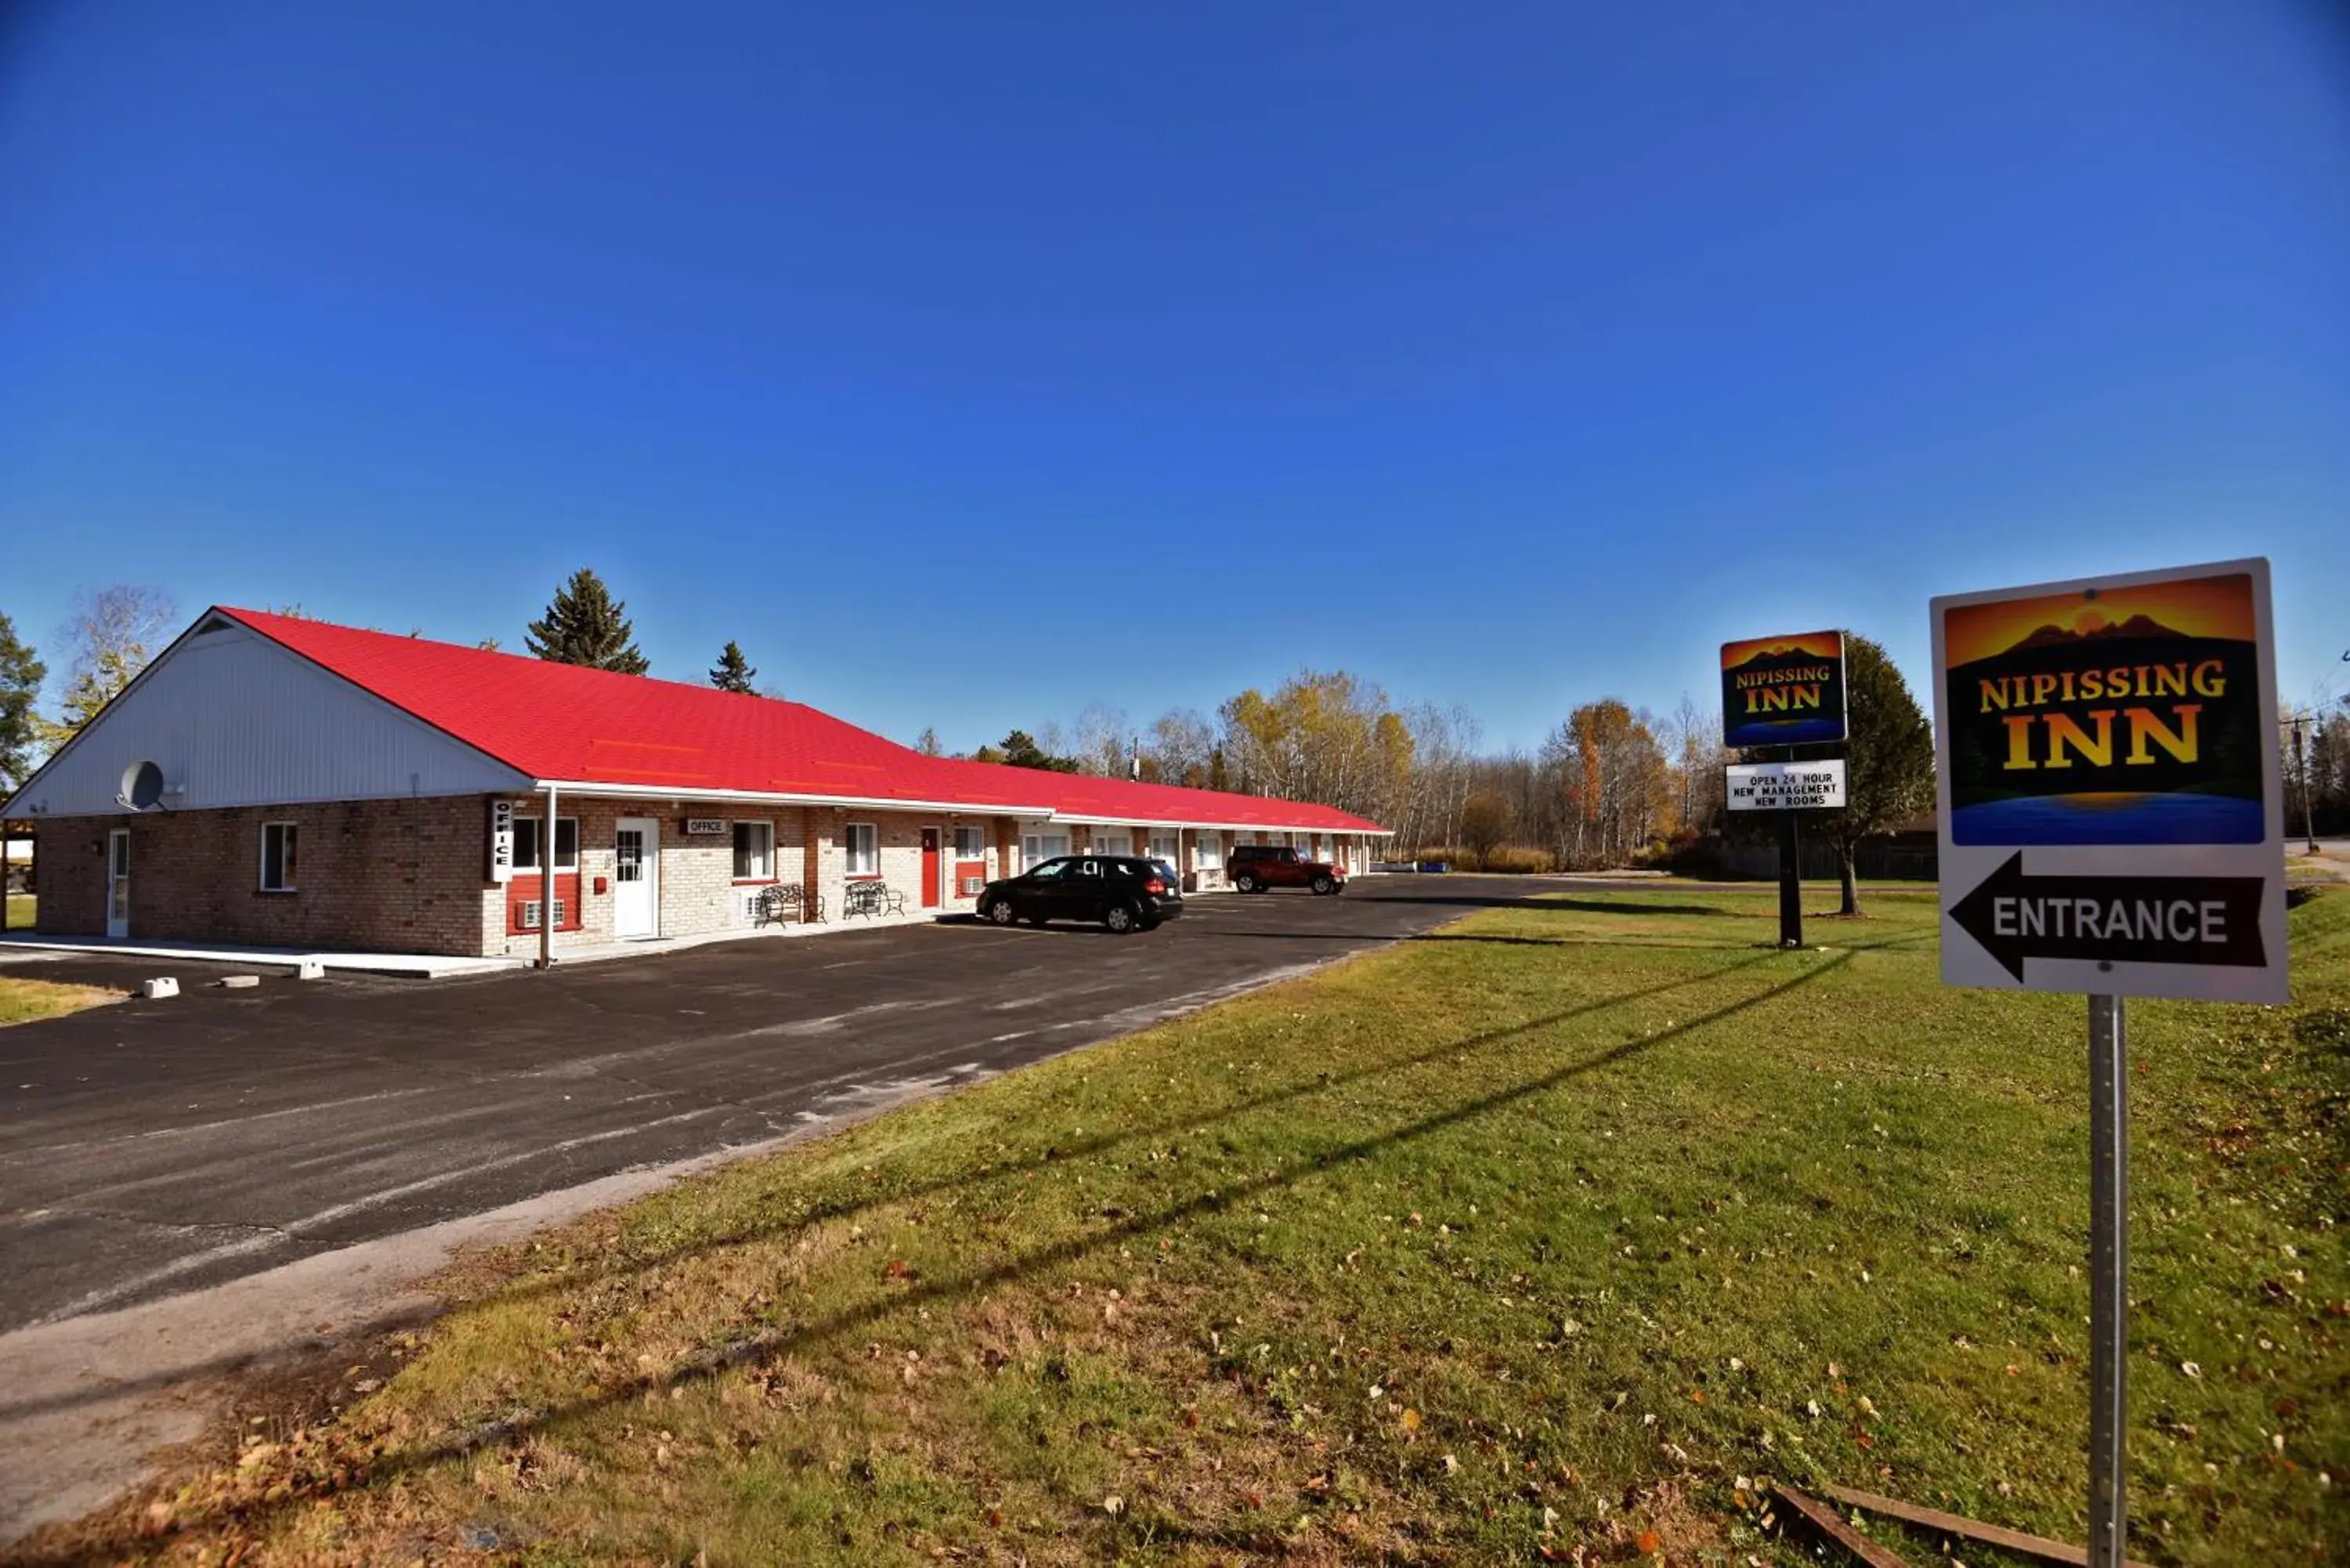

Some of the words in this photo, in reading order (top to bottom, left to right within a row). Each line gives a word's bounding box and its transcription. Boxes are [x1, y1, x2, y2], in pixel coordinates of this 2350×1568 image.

[1736, 666, 1831, 689] NIPISSING
[1979, 659, 2227, 713] NIPISSING
[1744, 682, 1822, 714] INN
[2002, 705, 2203, 770] INN
[1734, 787, 1755, 797] NEW
[1762, 784, 1837, 796] MANAGEMENT
[1750, 776, 1777, 786] OPEN
[1783, 775, 1796, 784] 24
[1803, 773, 1833, 783] HOUR
[1755, 797, 1777, 806] NEW
[1786, 796, 1826, 805] ROOMS
[496, 803, 510, 865] OFFICE
[691, 821, 722, 831] OFFICE
[1993, 896, 2228, 943] ENTRANCE
